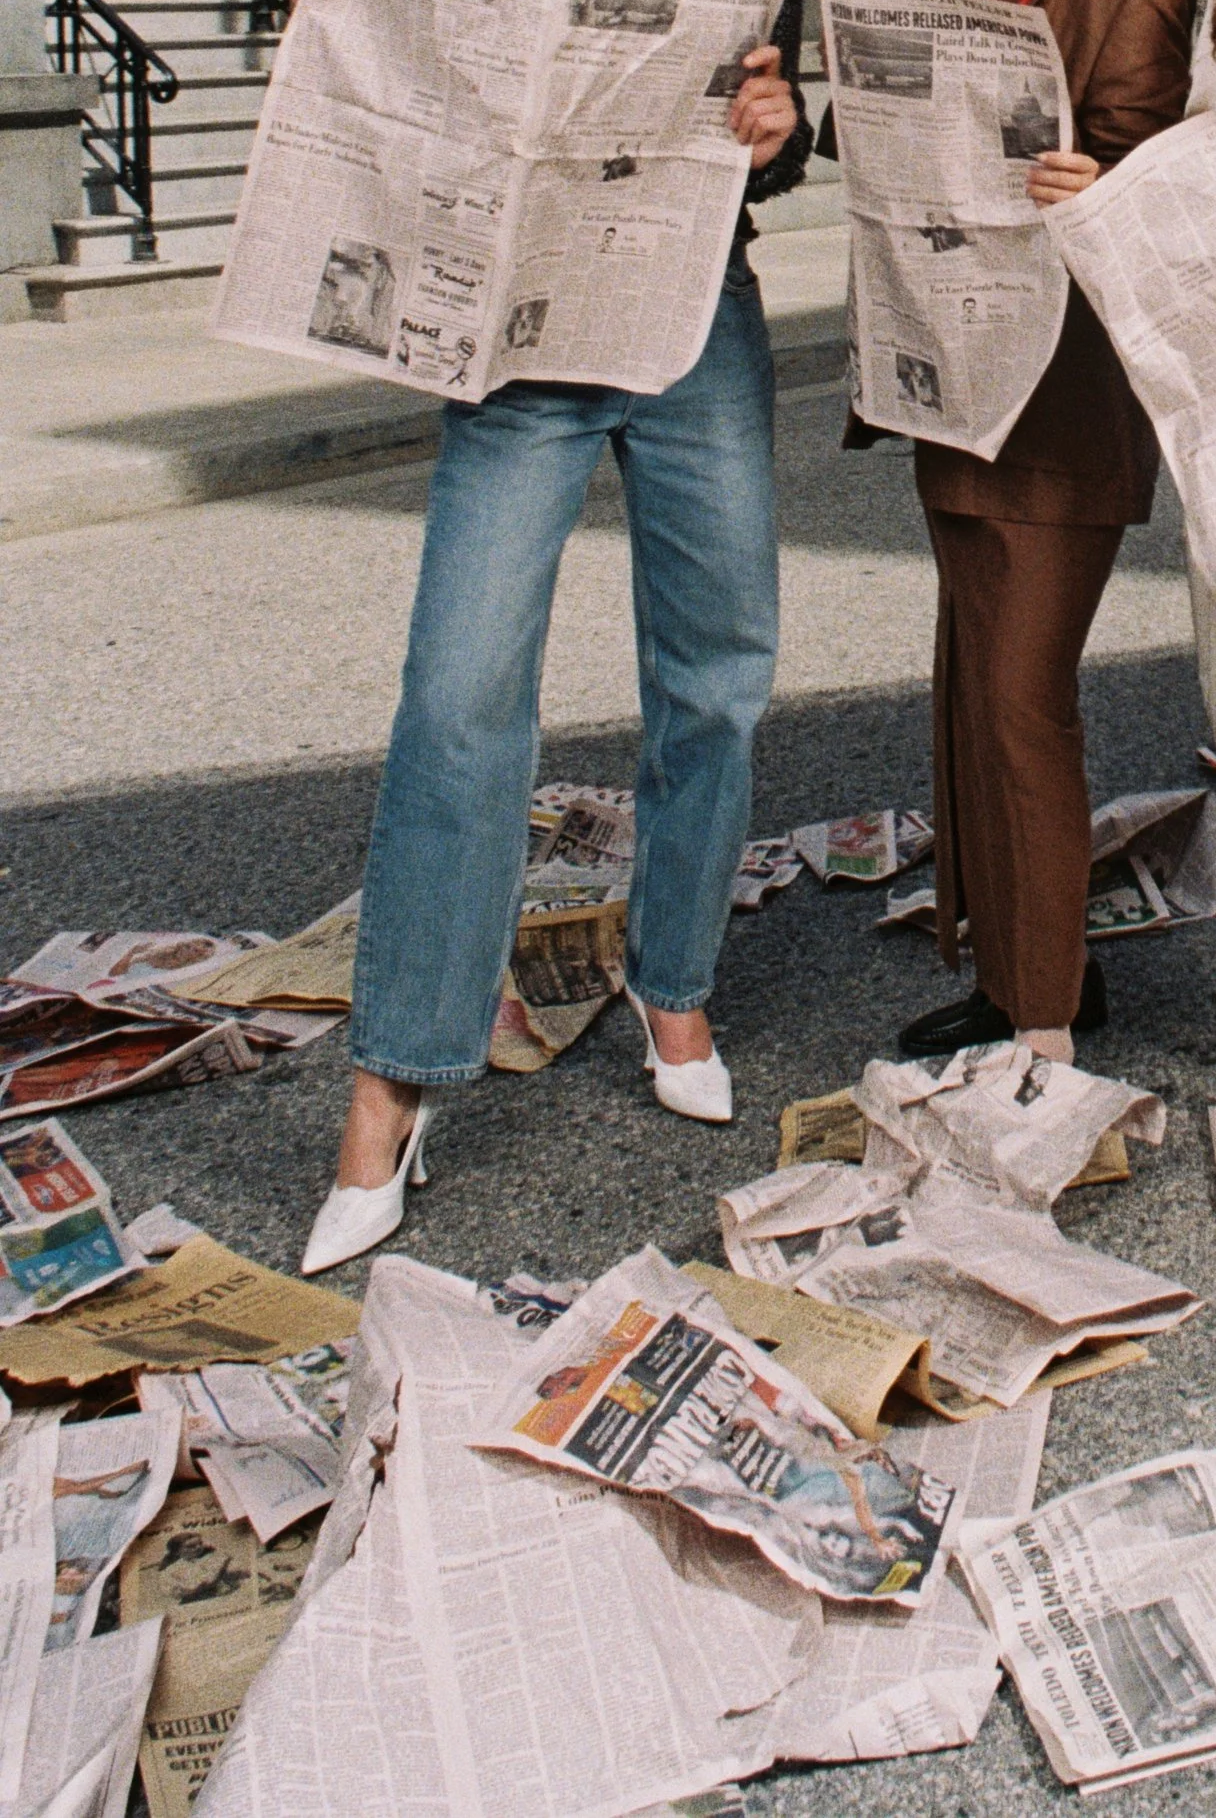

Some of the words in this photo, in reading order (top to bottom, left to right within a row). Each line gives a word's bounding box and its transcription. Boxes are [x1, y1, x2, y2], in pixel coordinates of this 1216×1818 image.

[855, 6, 911, 27] WELCOMES
[912, 12, 963, 30] RELEASED
[965, 16, 1018, 38] AMERICAN
[960, 0, 1013, 19] TELLER
[935, 49, 963, 64] Plays
[965, 52, 997, 66] Down
[968, 37, 991, 49] Talk
[401, 318, 442, 340] PALACE
[74, 1270, 258, 1336] Resigns
[991, 1551, 1026, 1611] TELLER
[1023, 1543, 1064, 1608] AMERICAN
[1017, 1620, 1049, 1661] TRTH
[1041, 1666, 1080, 1730] TOLEDO
[1070, 1649, 1120, 1723] WELCOMES
[1103, 1716, 1141, 1759] NIXON
[170, 1758, 213, 1772] GETS
